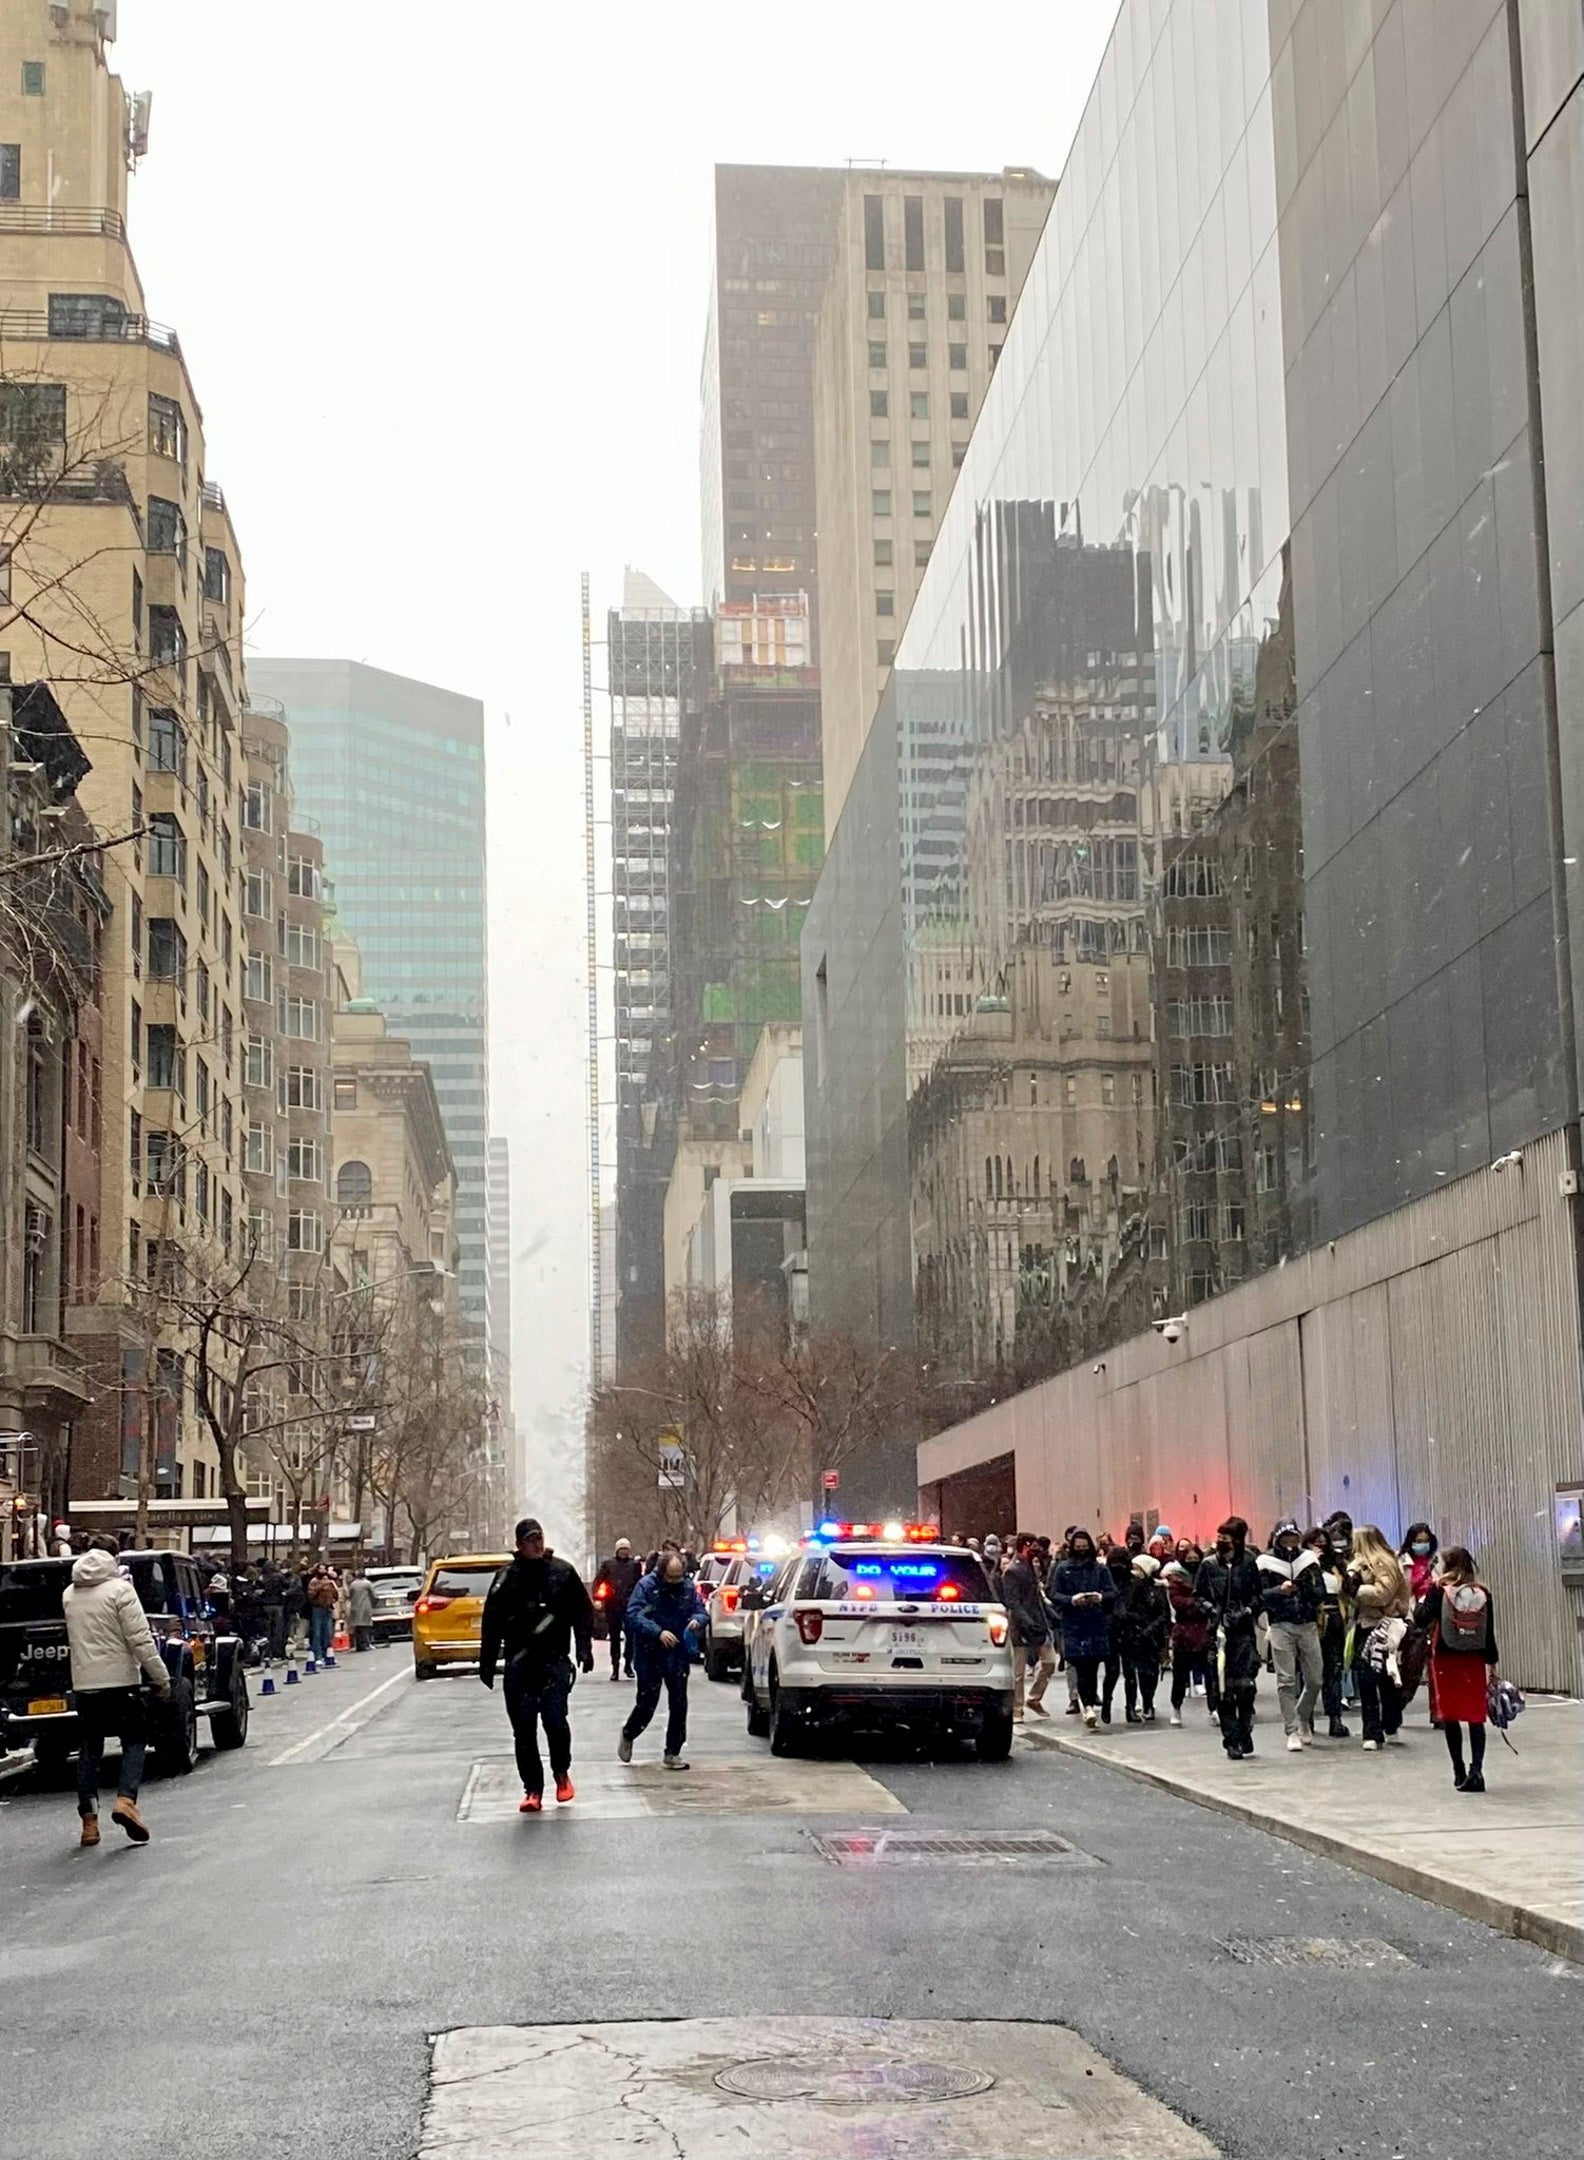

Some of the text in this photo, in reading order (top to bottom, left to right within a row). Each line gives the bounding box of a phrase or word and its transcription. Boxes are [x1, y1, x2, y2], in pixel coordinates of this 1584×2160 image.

[856, 1564, 937, 1576] DO YOUR
[839, 1603, 878, 1613] NYPD
[930, 1604, 980, 1614] POLICE
[19, 1644, 71, 1661] Jeep
